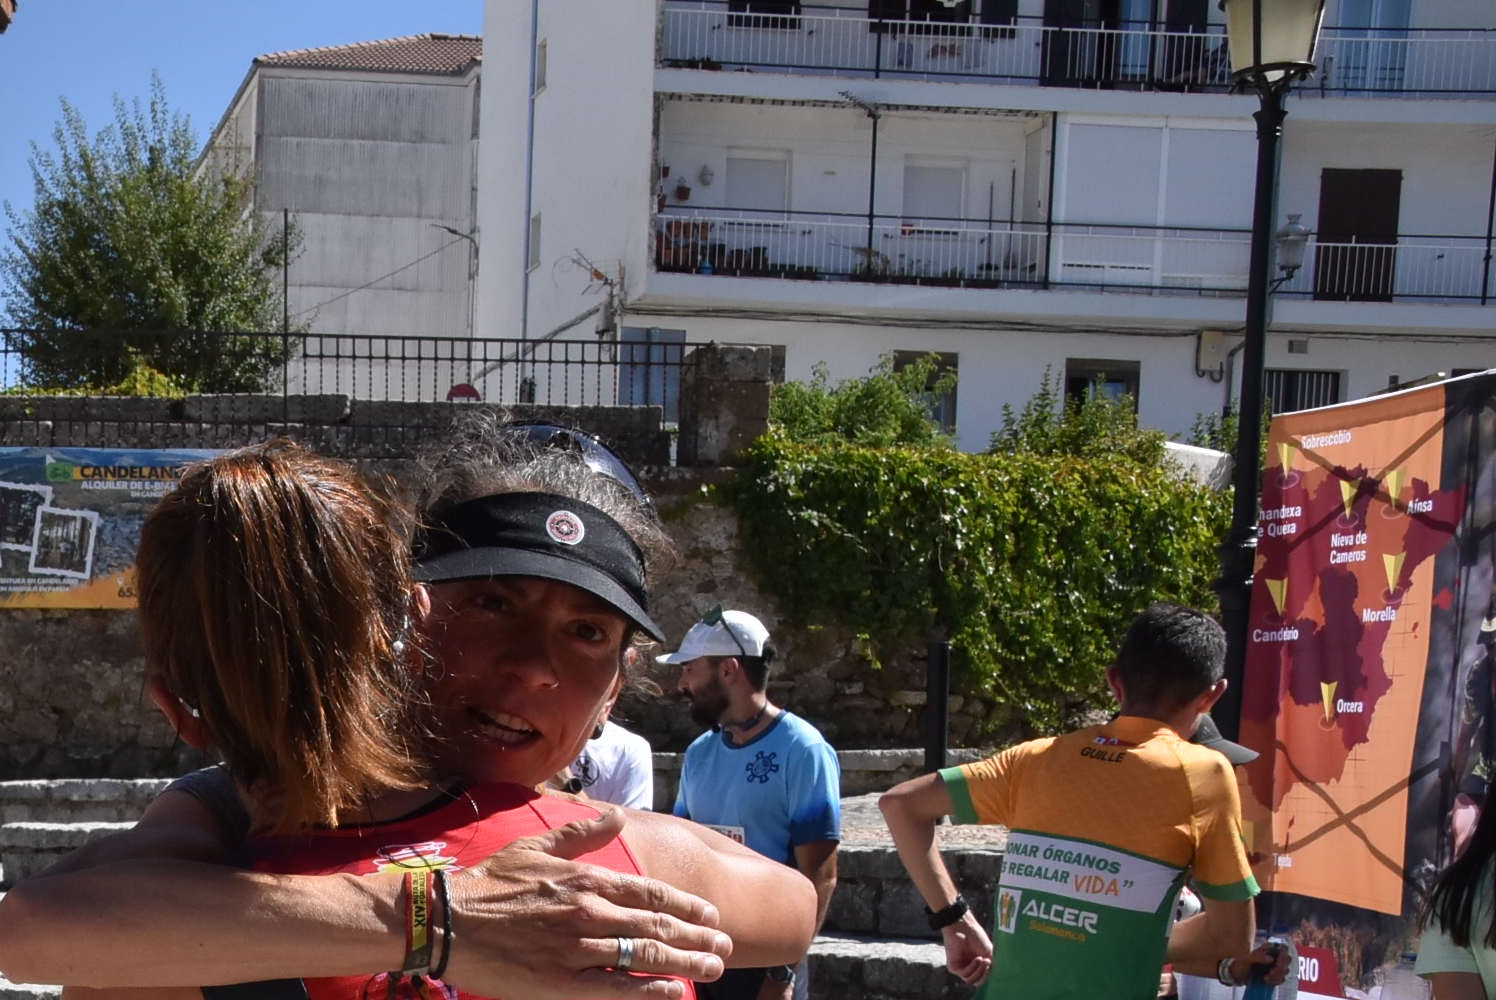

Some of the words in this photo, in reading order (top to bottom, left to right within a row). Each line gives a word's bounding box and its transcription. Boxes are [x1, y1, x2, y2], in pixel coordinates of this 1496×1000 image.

[1301, 431, 1352, 449] Sobrescobio
[81, 481, 127, 491] ALQUILER
[1407, 498, 1433, 514] Aínsa
[1331, 533, 1354, 548] Nieva
[1355, 531, 1367, 545] de
[1330, 549, 1366, 565] Cameros
[1362, 606, 1397, 623] Morella
[1336, 699, 1363, 714] Orcera
[1080, 746, 1126, 763] GUILLE
[1043, 844, 1122, 874] ÓRGANOS
[1009, 862, 1070, 883] REGALAR
[1022, 898, 1099, 935] ALCER
